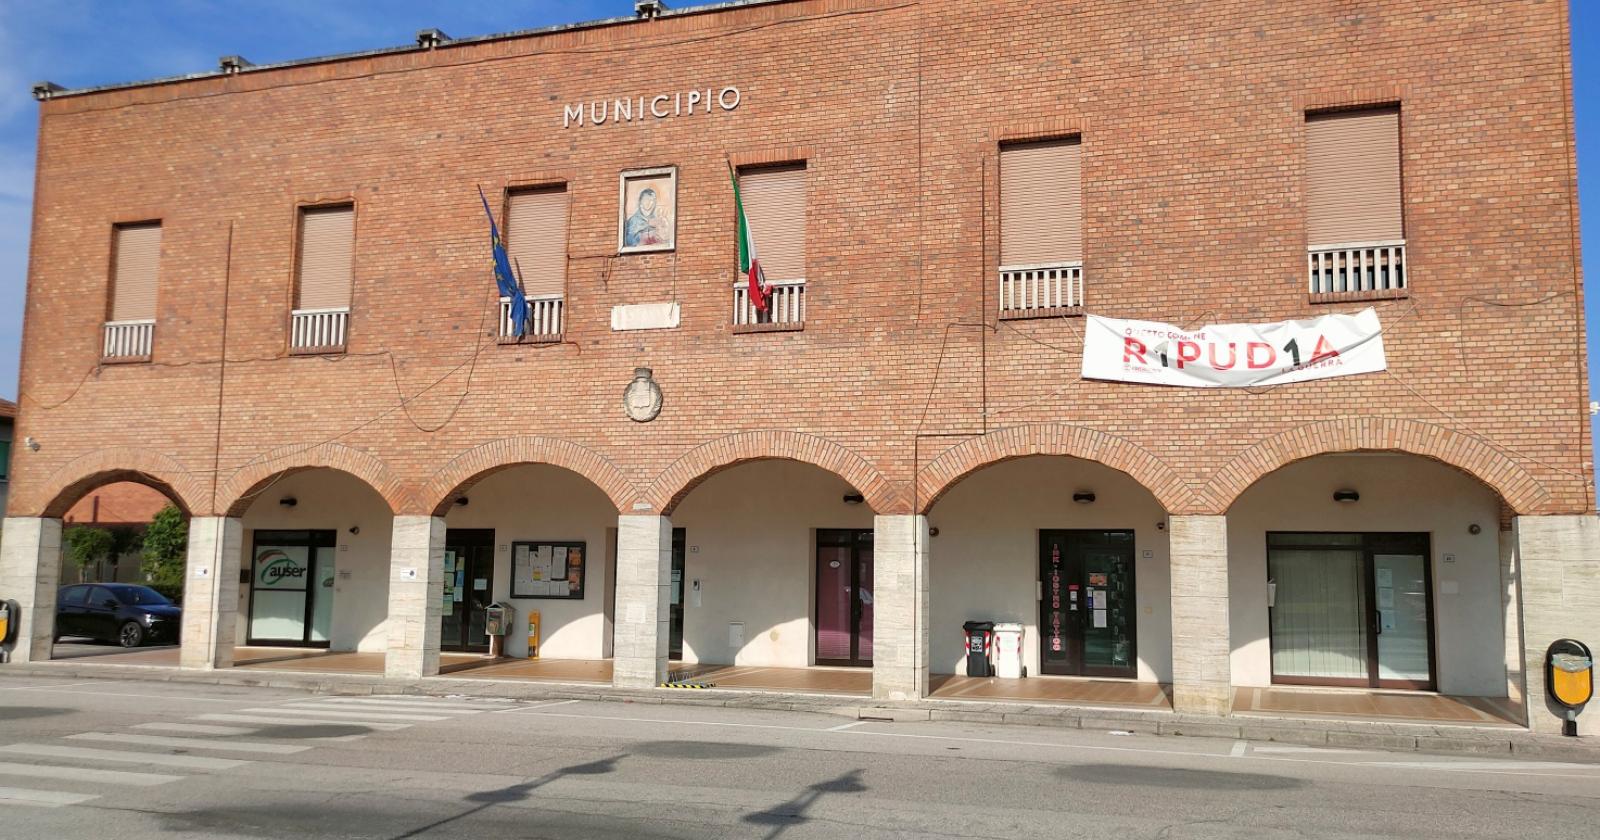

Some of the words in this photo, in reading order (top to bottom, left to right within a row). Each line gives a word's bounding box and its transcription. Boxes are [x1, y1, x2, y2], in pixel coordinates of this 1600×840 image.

[563, 86, 741, 128] MUNICIPIO
[269, 566, 305, 577] auser
[1052, 611, 1061, 651] TATTOO
